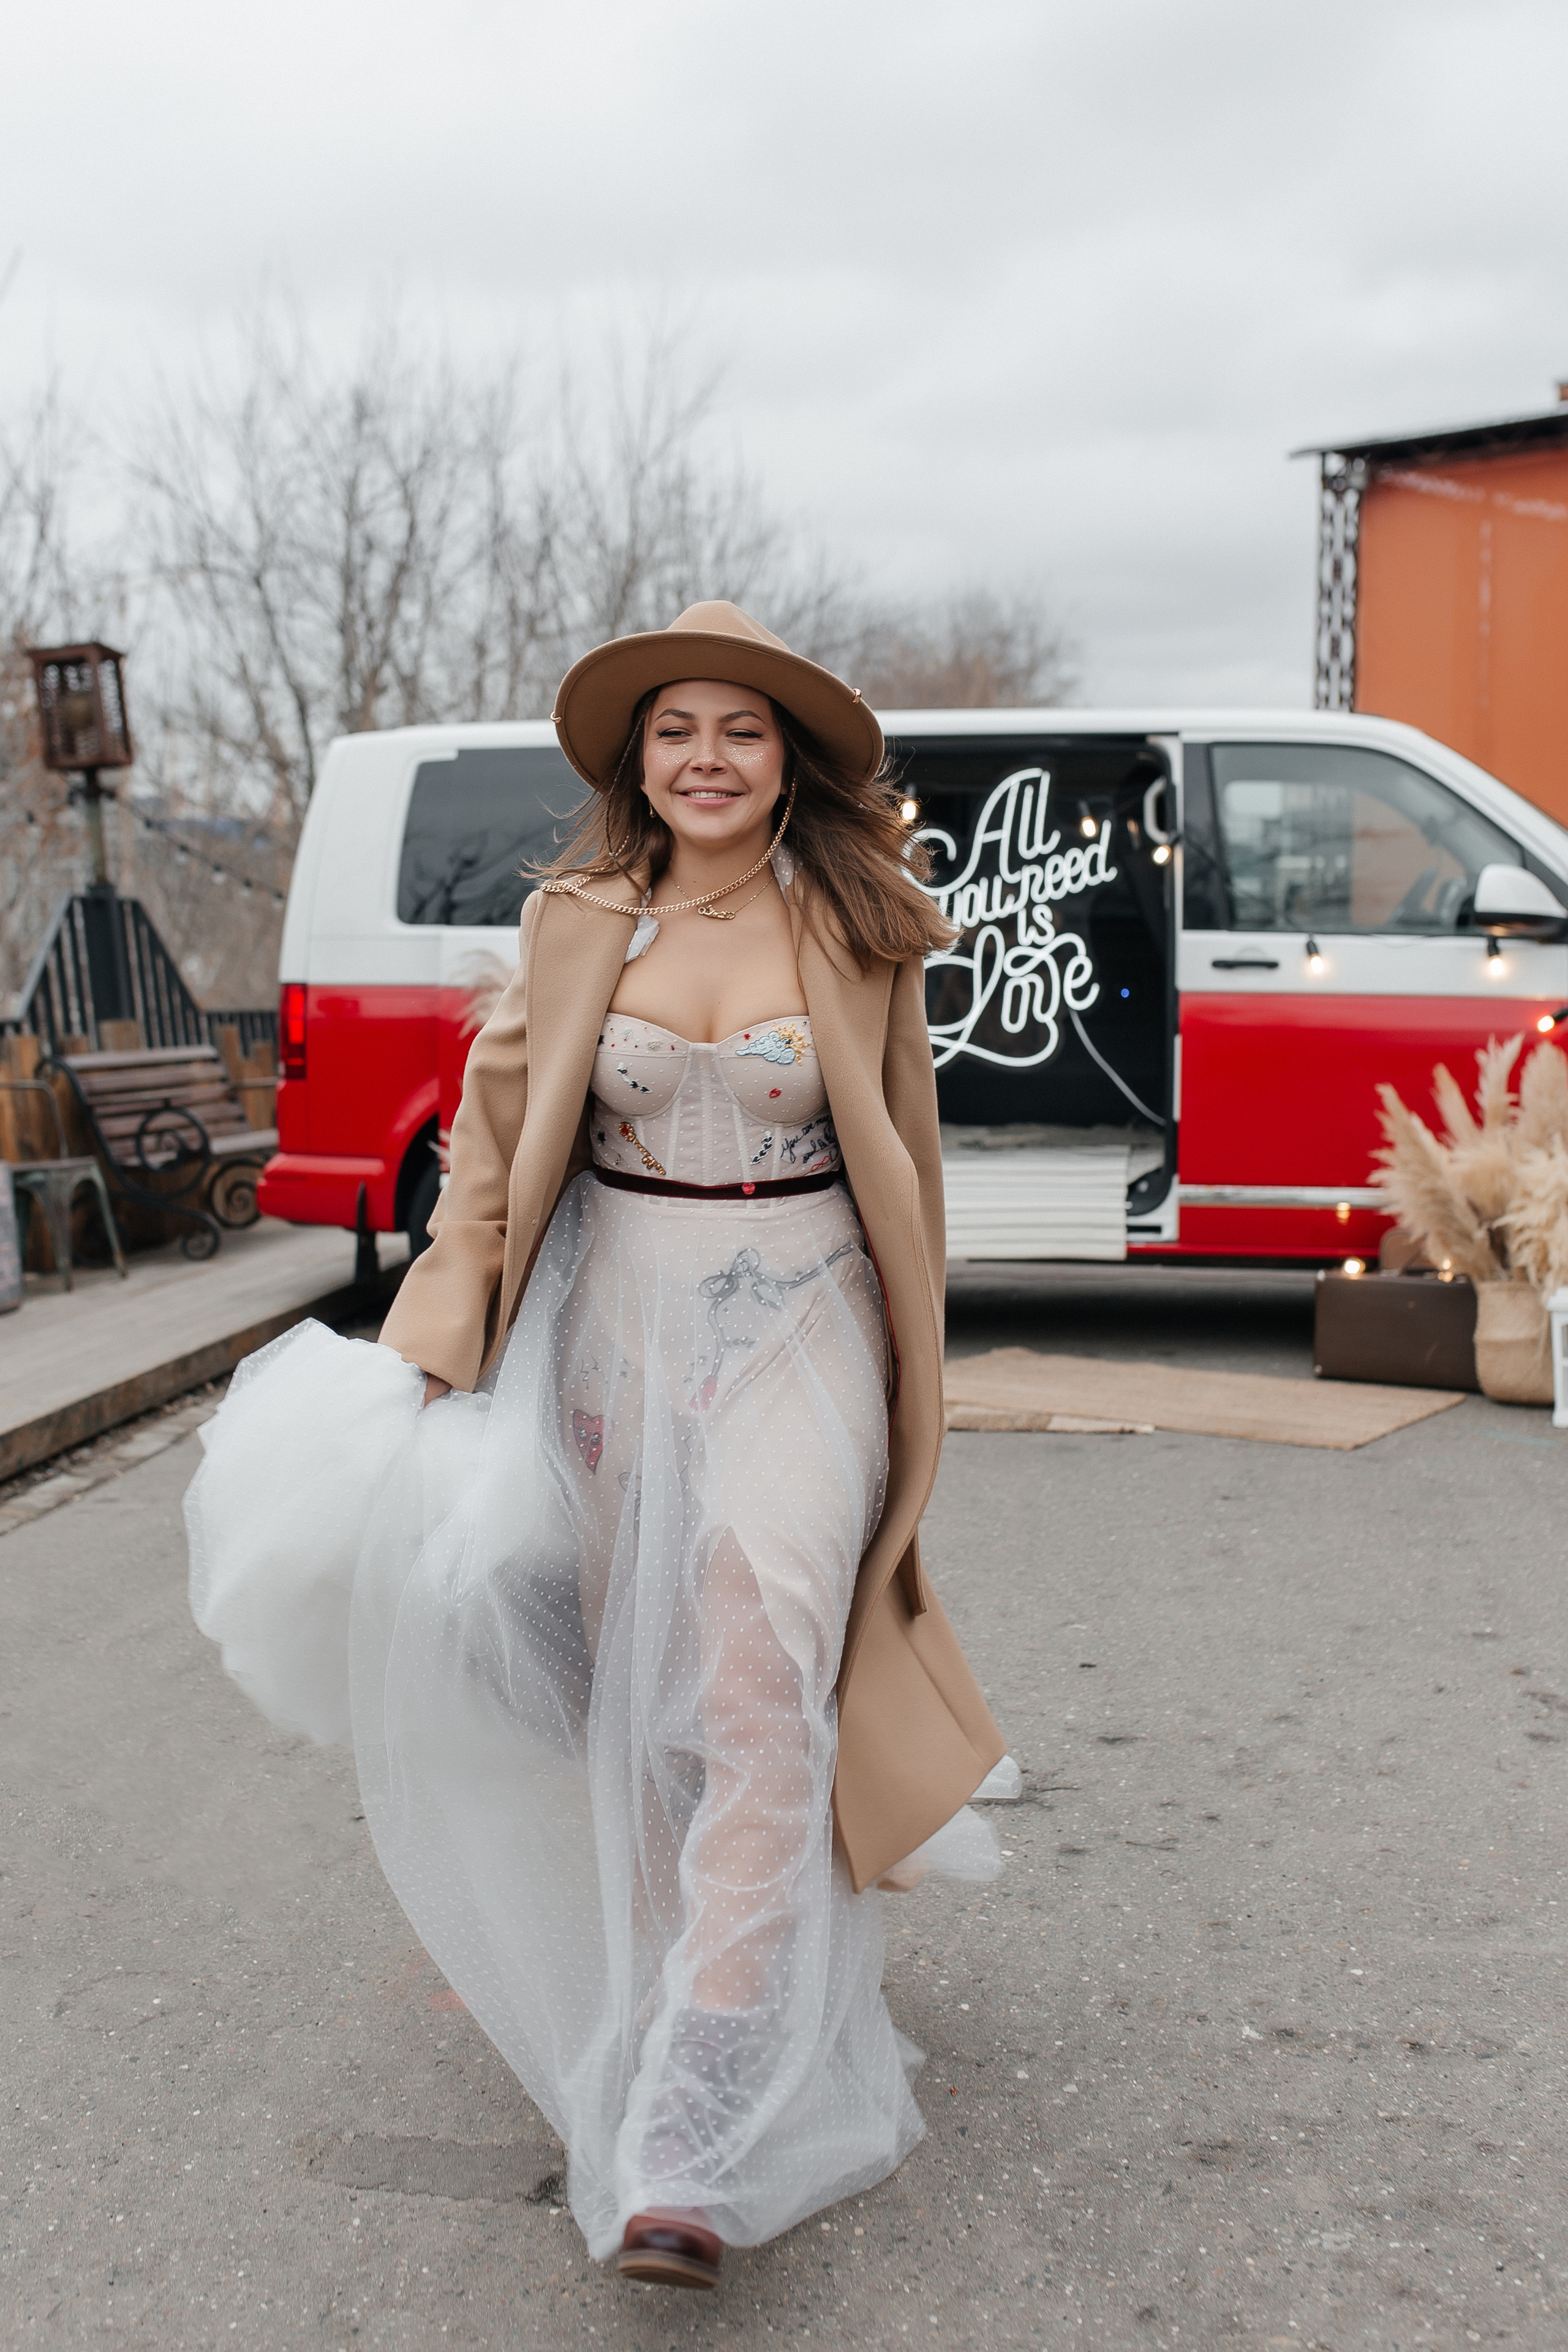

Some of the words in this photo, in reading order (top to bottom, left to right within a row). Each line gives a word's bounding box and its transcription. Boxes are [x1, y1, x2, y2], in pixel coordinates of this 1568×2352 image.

[902, 767, 1061, 897] All
[1011, 820, 1118, 913] need
[1017, 903, 1055, 946] is
[924, 925, 1100, 1068] Love
